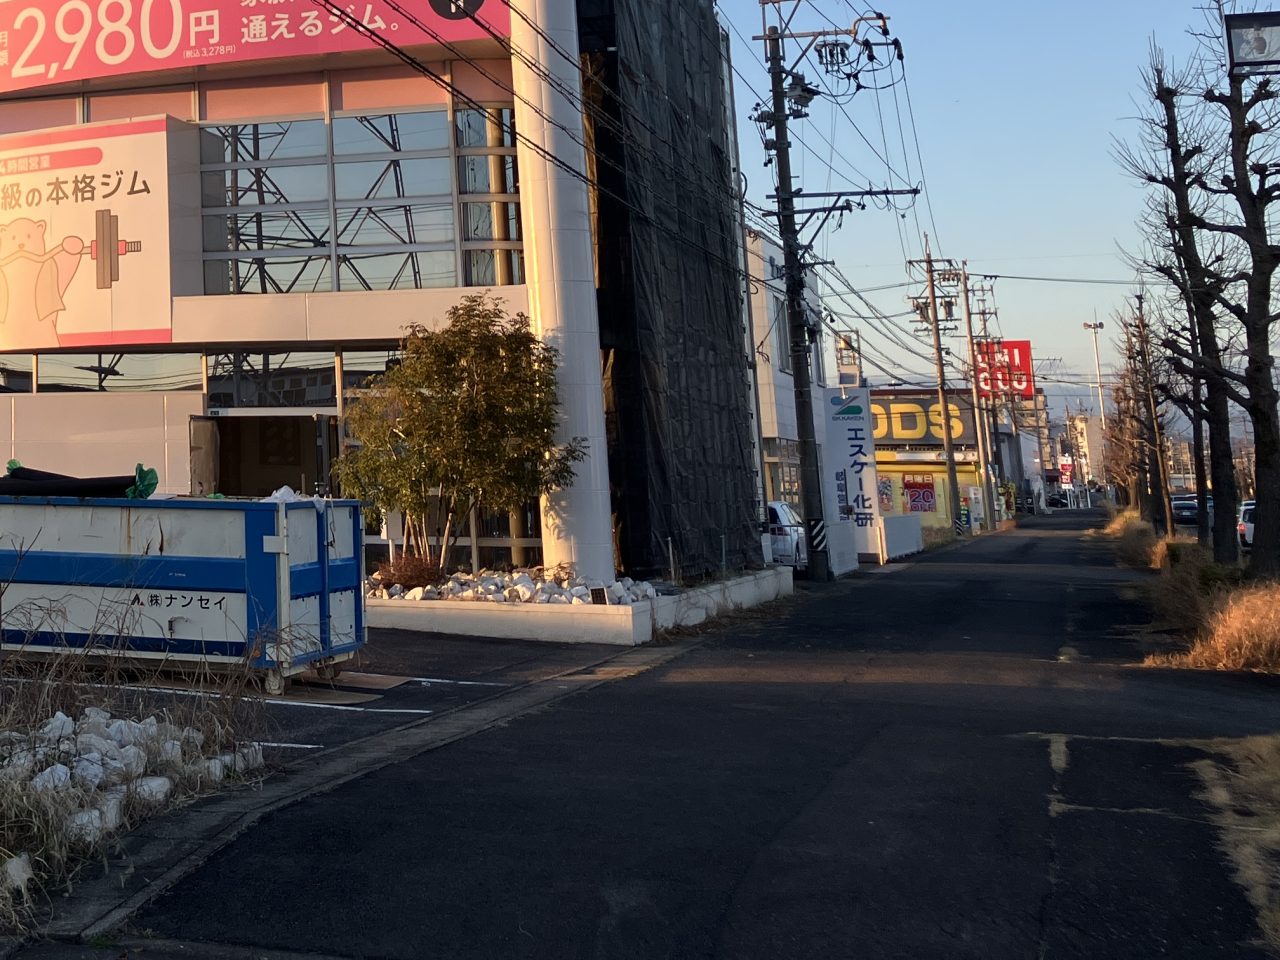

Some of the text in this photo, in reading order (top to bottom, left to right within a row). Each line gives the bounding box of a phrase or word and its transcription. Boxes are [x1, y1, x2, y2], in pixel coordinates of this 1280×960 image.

[240, 4, 399, 44] 通えるジム。
[847, 428, 874, 527] エスケー化研
